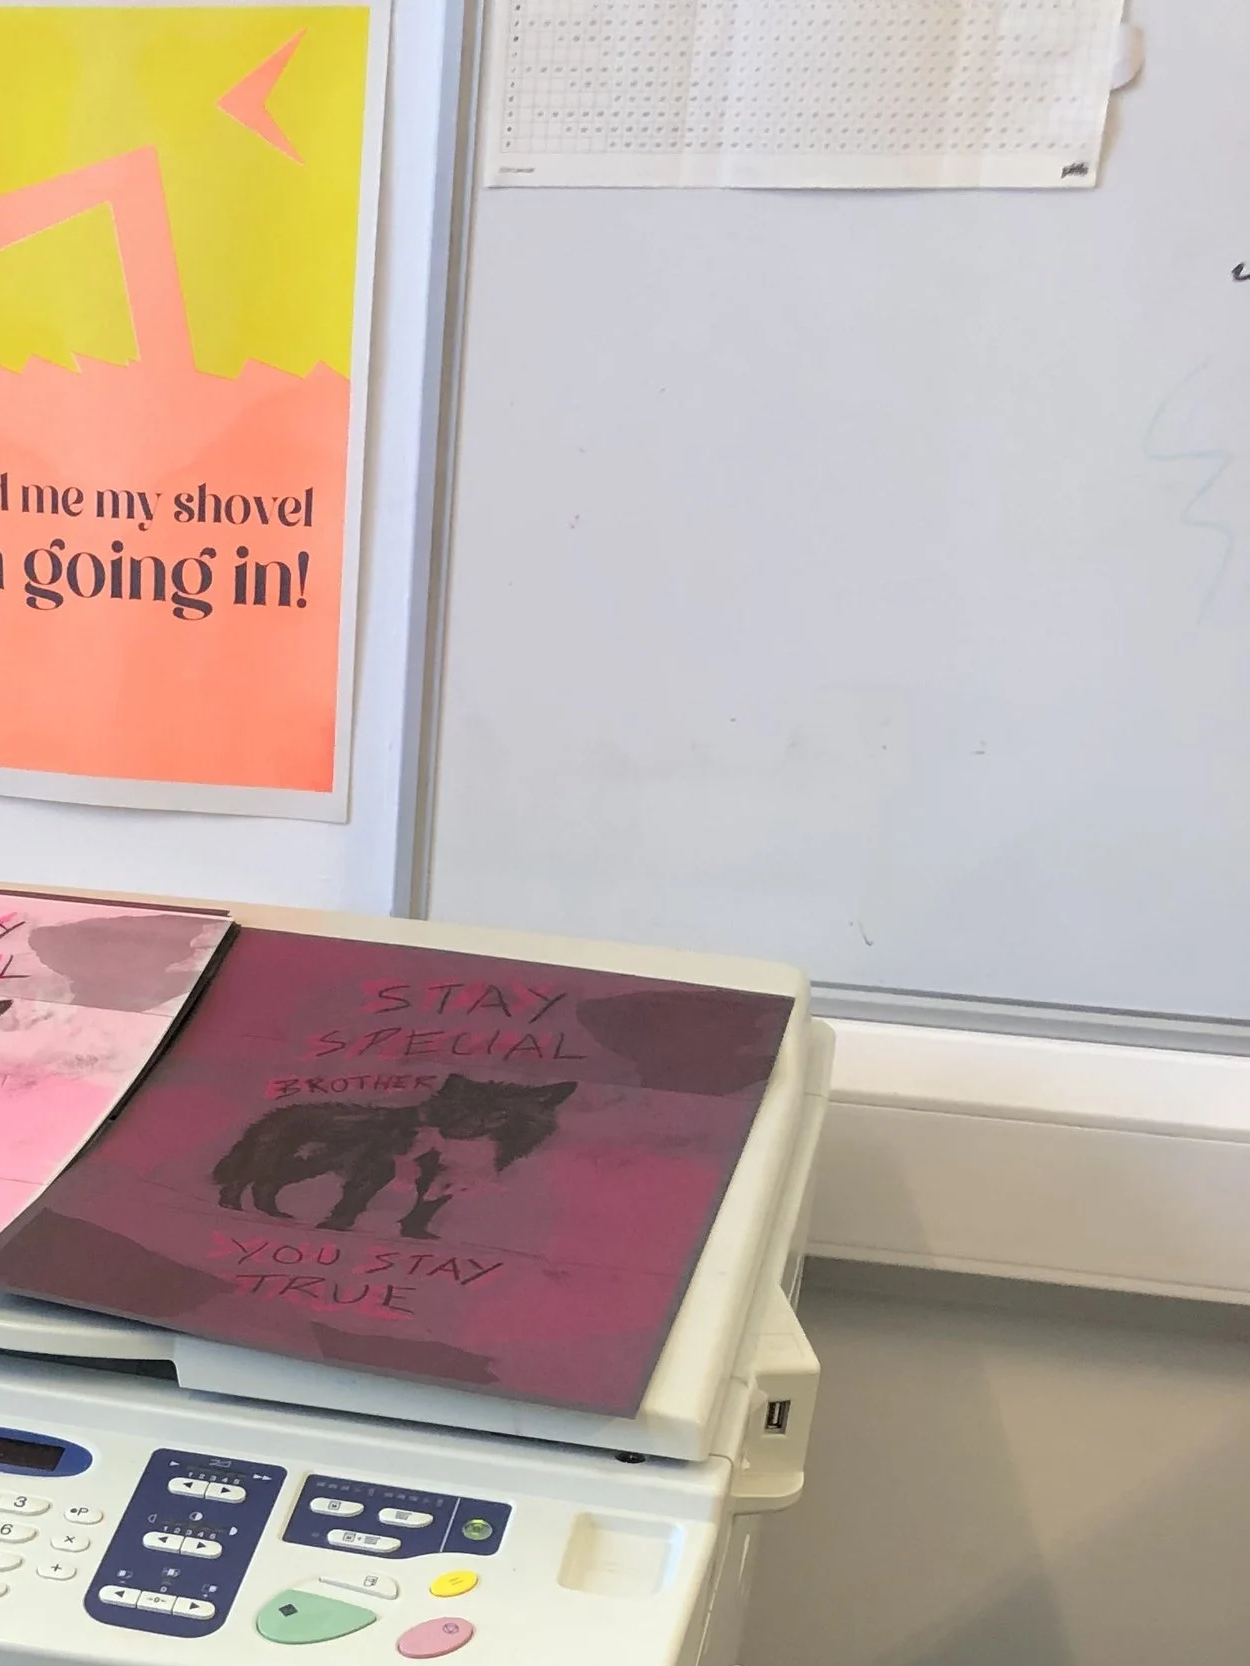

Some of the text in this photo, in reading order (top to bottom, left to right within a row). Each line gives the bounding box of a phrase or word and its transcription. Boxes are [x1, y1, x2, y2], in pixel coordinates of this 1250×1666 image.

[21, 484, 84, 517] me
[95, 487, 161, 531] my
[173, 483, 314, 527] shovel
[24, 538, 217, 621] going
[233, 546, 310, 609] in!
[362, 979, 567, 1024] STAY
[305, 1027, 587, 1061] SPECIAL
[267, 1074, 437, 1100] BROTHER
[216, 1234, 504, 1286] YOU STAY
[230, 1273, 416, 1317] TRUE
[13, 1496, 28, 1508] 3
[0, 1523, 13, 1536] 6
